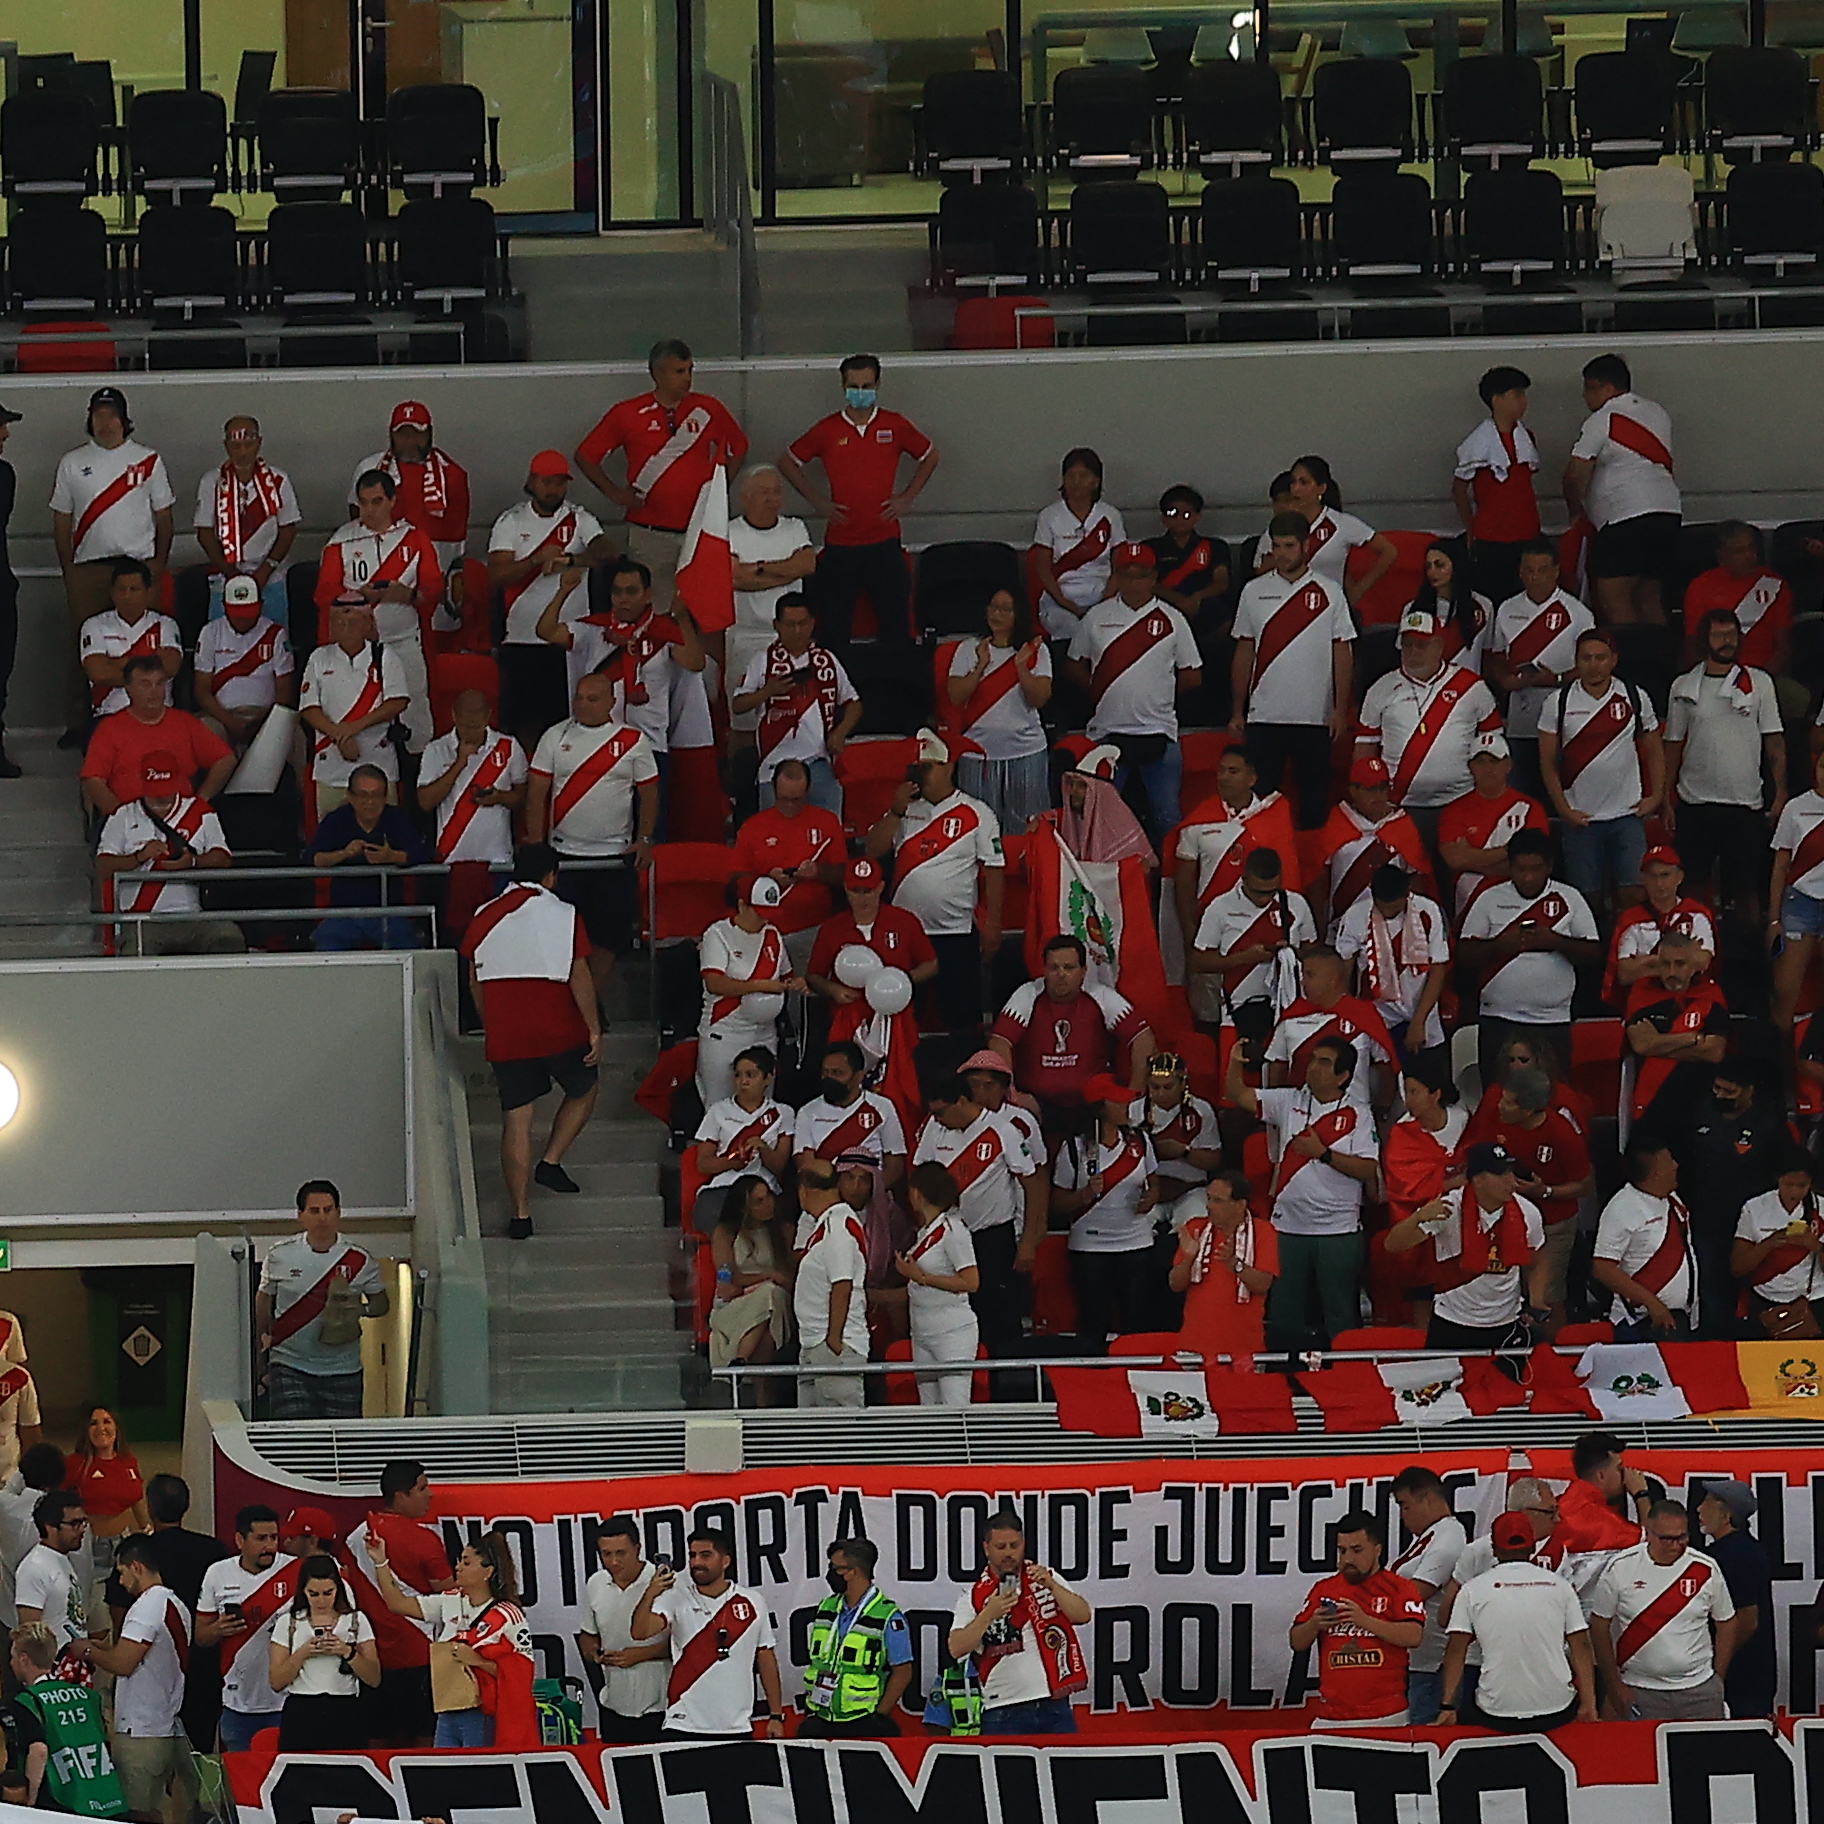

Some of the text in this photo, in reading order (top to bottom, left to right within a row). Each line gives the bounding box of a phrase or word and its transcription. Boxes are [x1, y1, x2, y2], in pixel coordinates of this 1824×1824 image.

[353, 560, 368, 582] 10
[1333, 1653, 1379, 1667] CRISTAL
[38, 1687, 89, 1705] PHOTO
[58, 1707, 88, 1726] 215
[53, 1742, 114, 1785] FIFA
